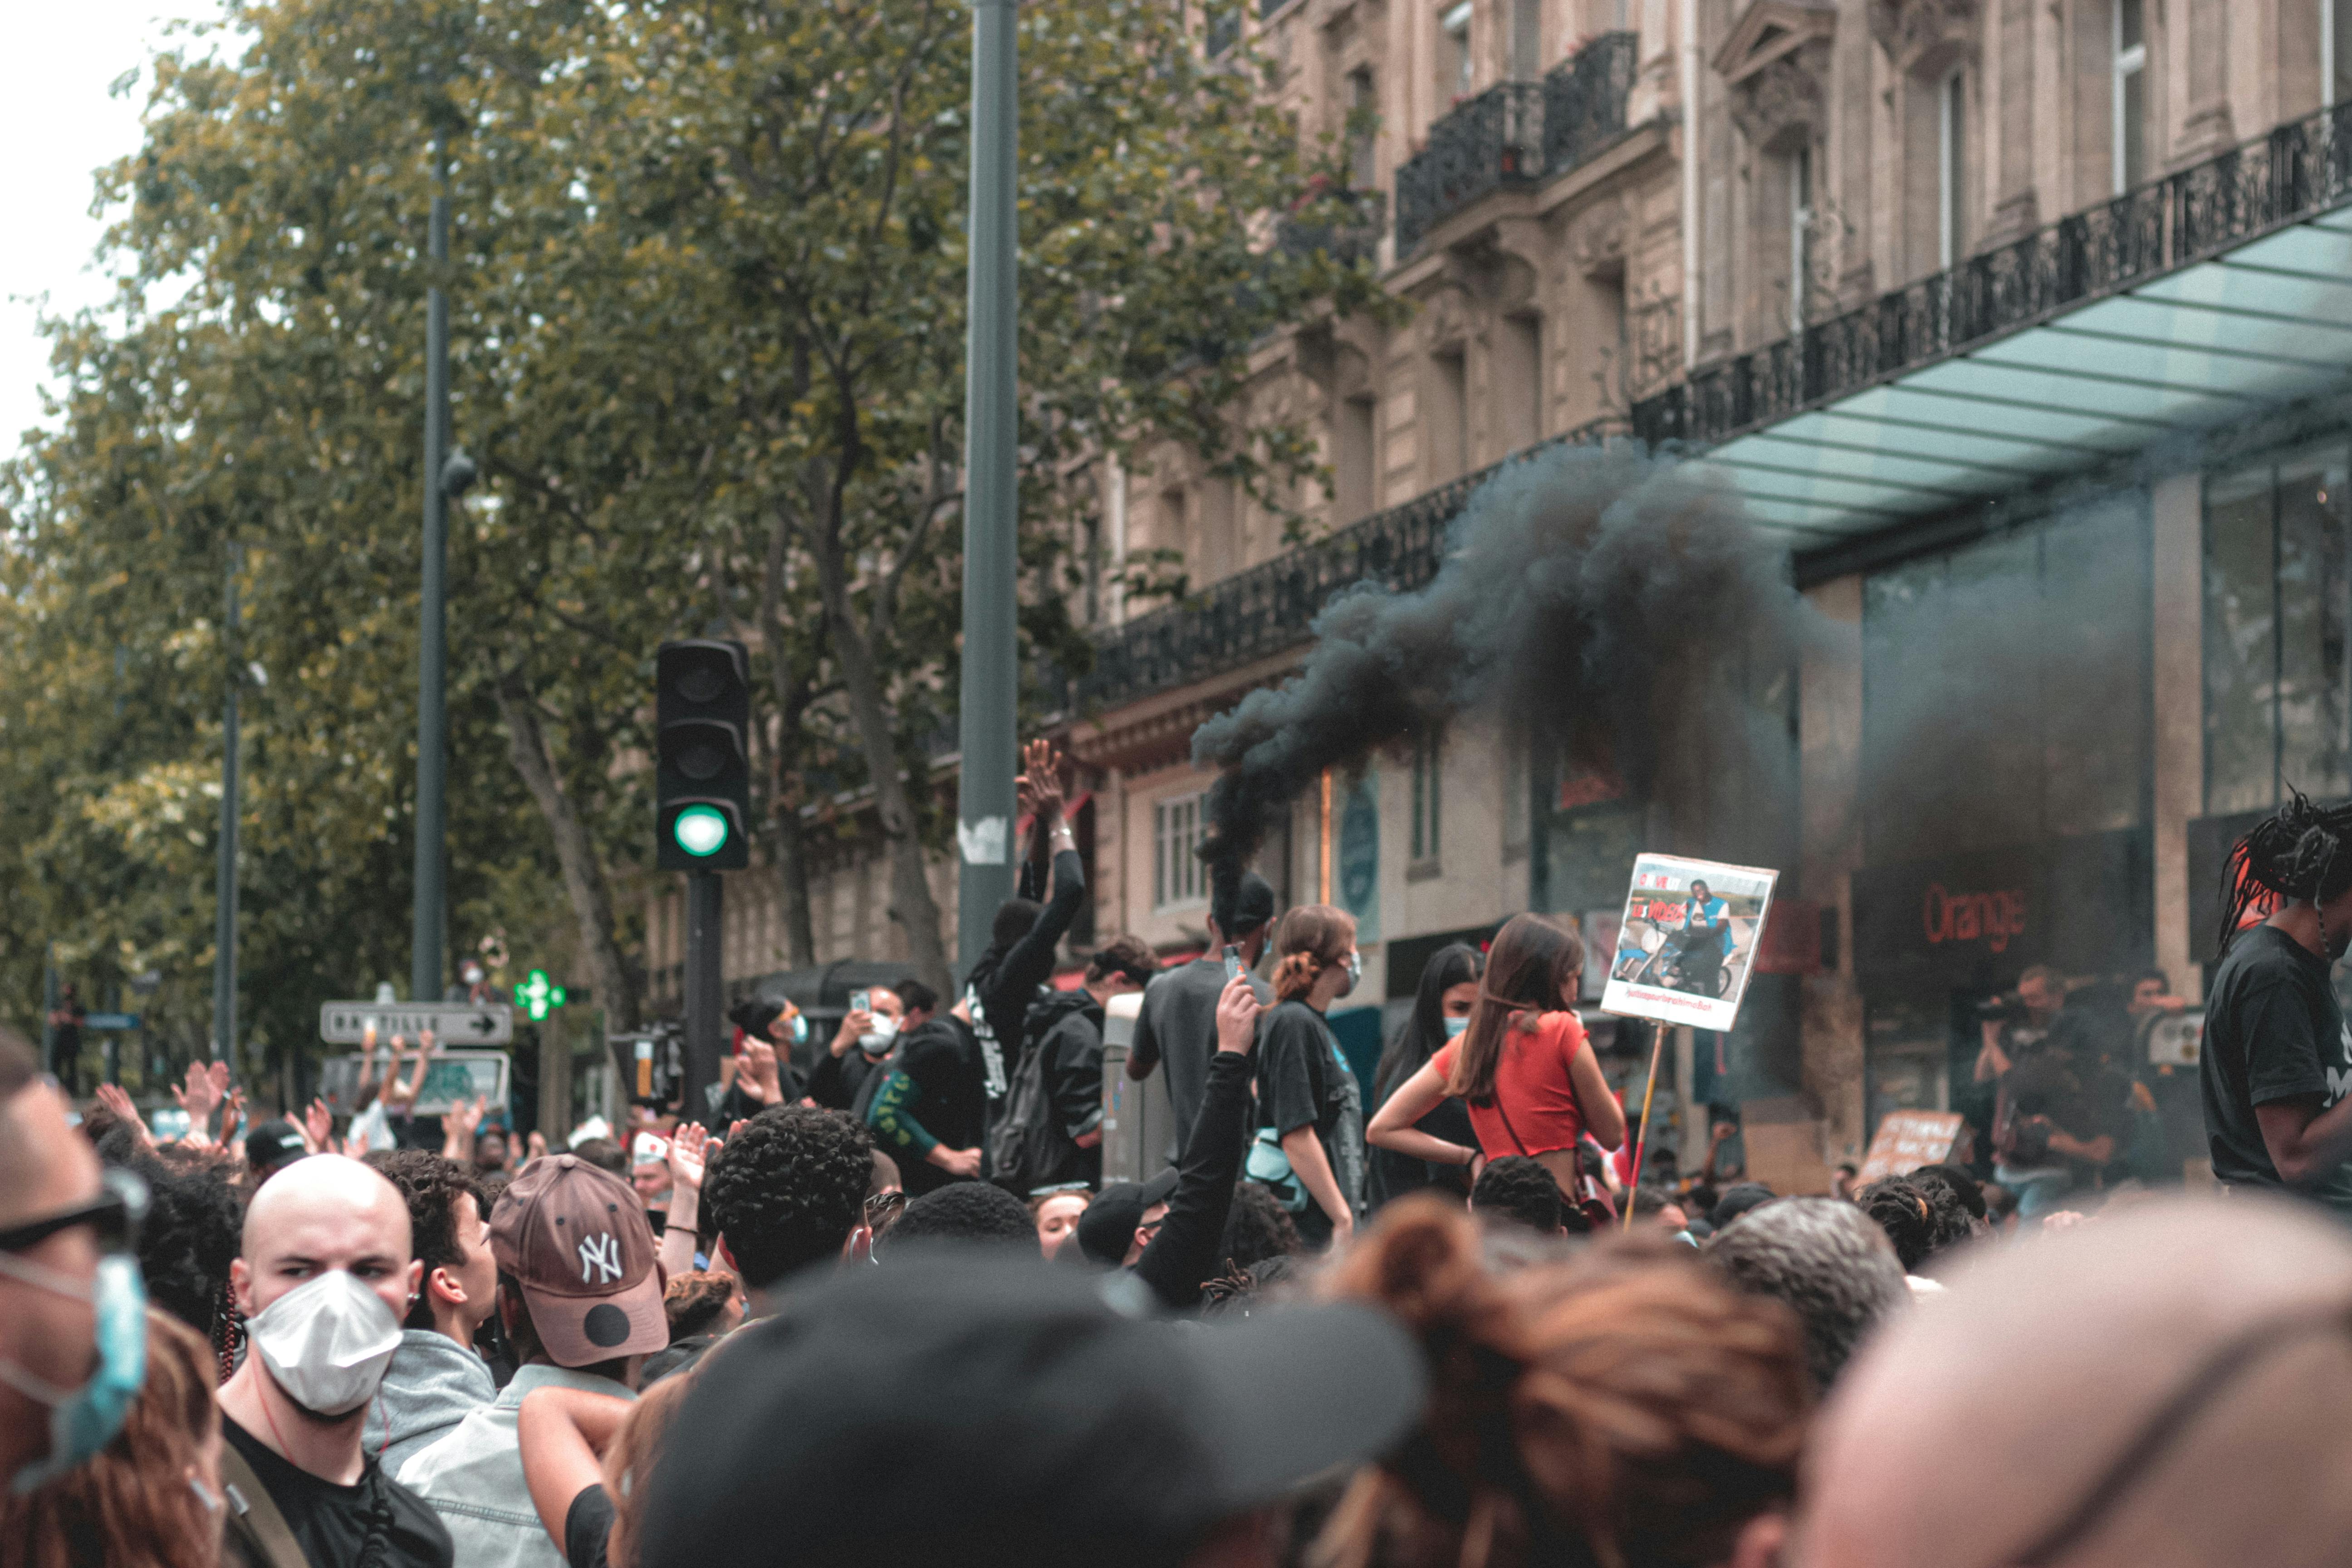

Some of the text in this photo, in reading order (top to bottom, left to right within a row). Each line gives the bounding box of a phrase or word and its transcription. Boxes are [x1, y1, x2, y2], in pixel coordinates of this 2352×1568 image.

[1924, 882, 2027, 952] Orange
[334, 1015, 439, 1032] BATILLE
[578, 1232, 622, 1284] NY
